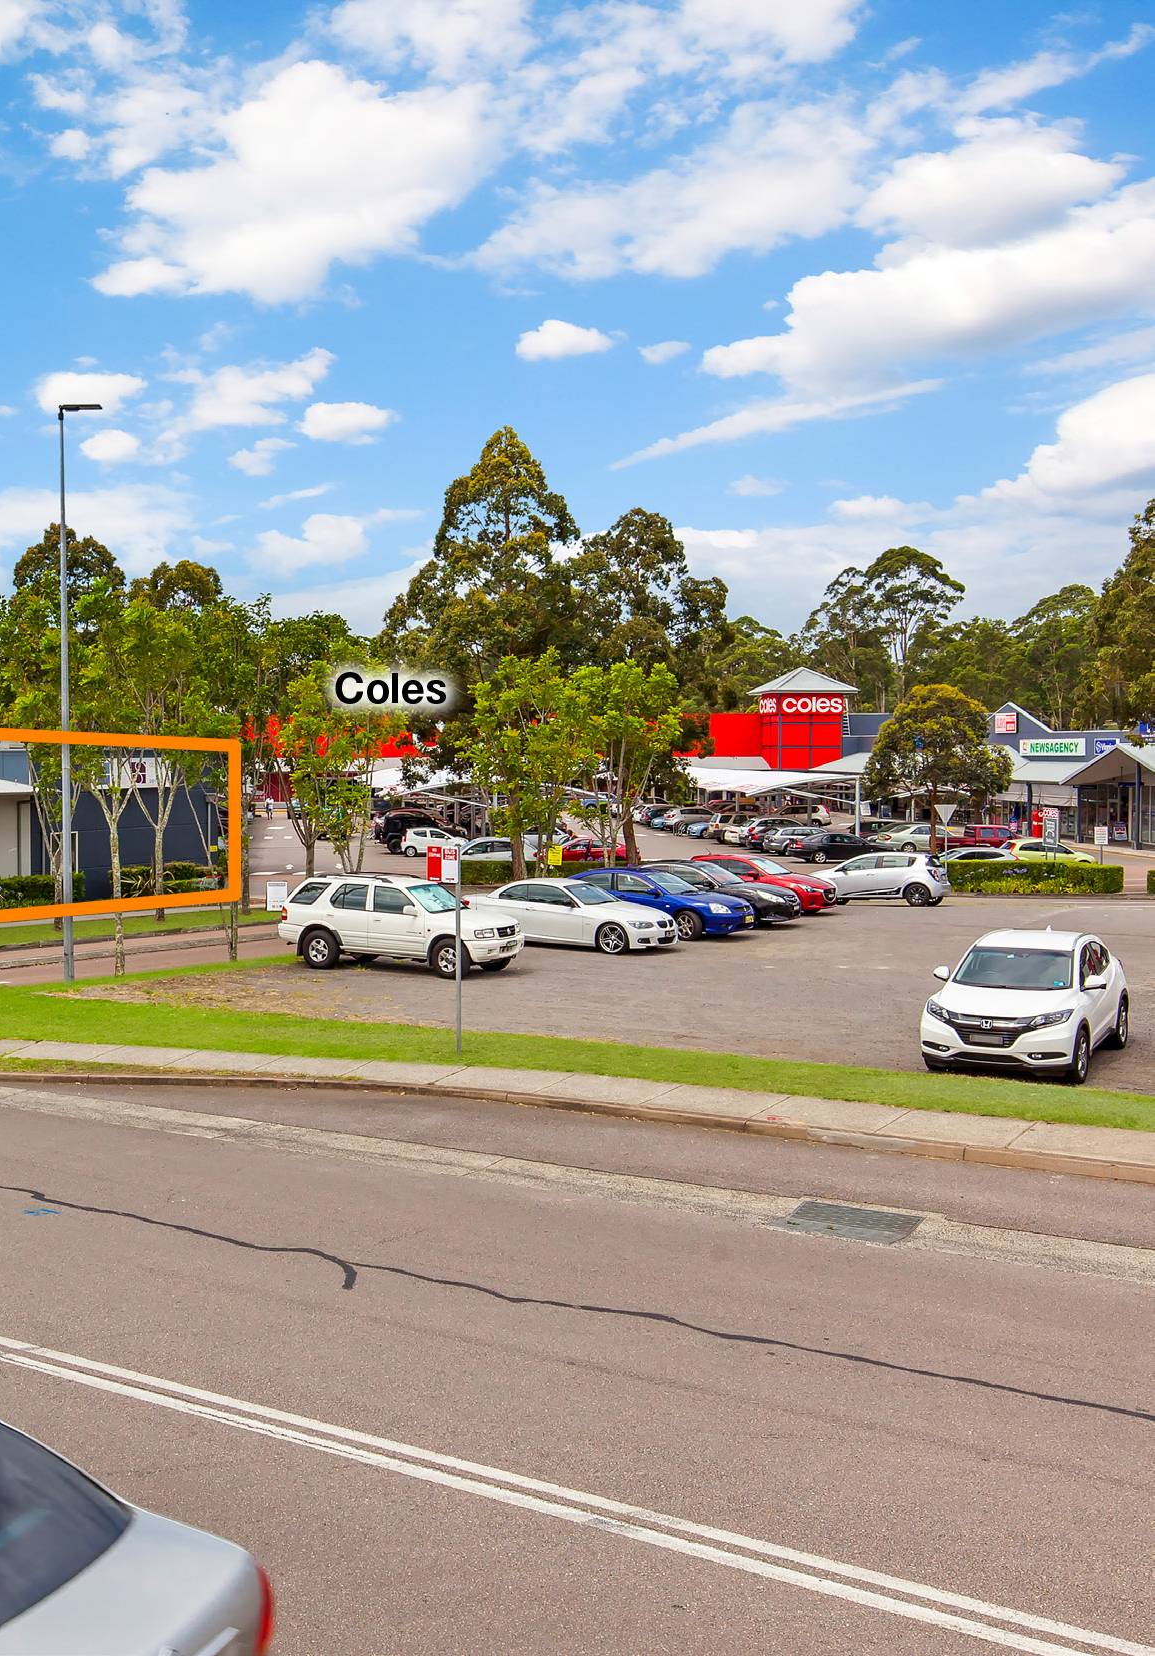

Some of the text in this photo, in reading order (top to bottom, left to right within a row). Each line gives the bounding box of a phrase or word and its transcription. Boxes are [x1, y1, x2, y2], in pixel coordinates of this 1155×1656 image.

[759, 698, 777, 713] coles
[782, 697, 843, 713] coles
[1030, 742, 1079, 753] NEWSAGENCY
